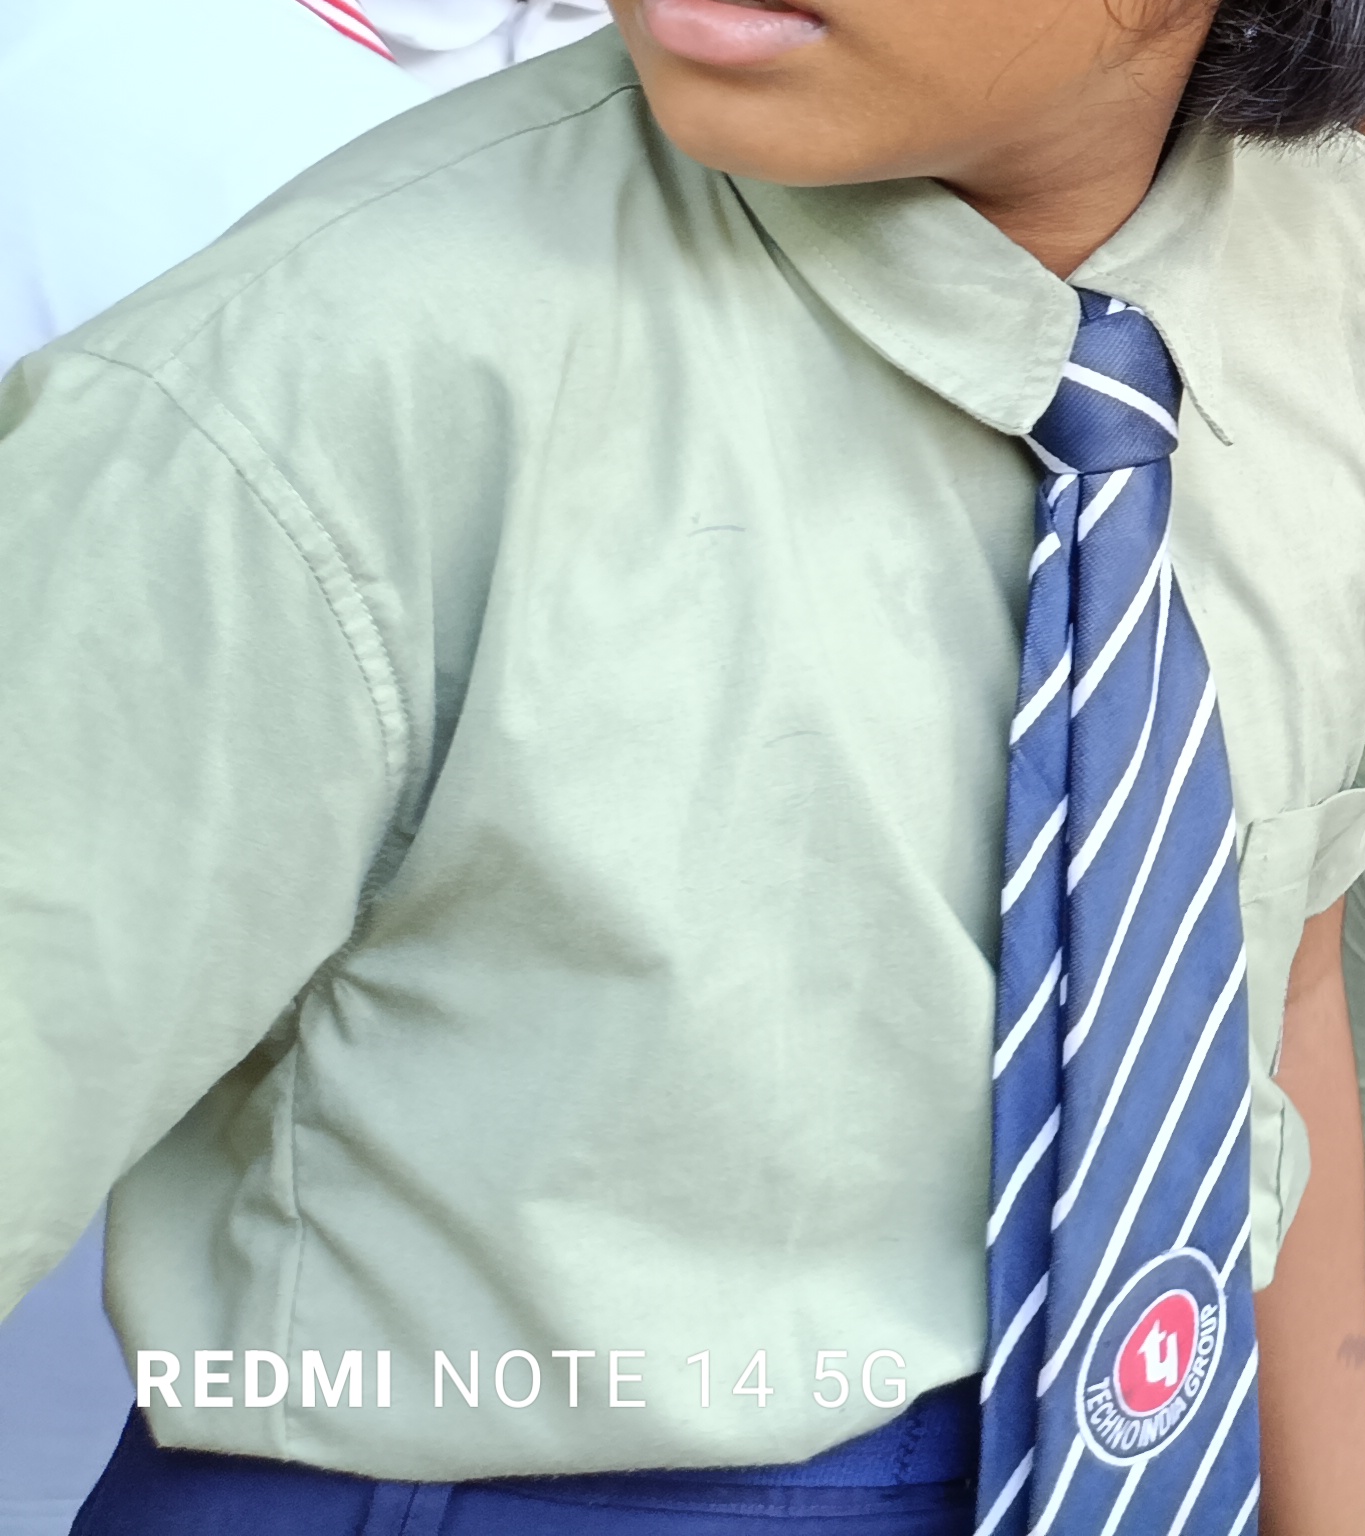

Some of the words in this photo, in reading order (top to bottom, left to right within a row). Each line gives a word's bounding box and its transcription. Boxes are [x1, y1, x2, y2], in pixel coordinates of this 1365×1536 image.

[1087, 1376, 1140, 1451] TECHNO
[1137, 1396, 1187, 1449] INDIA
[1184, 1303, 1219, 1398] GROUP
